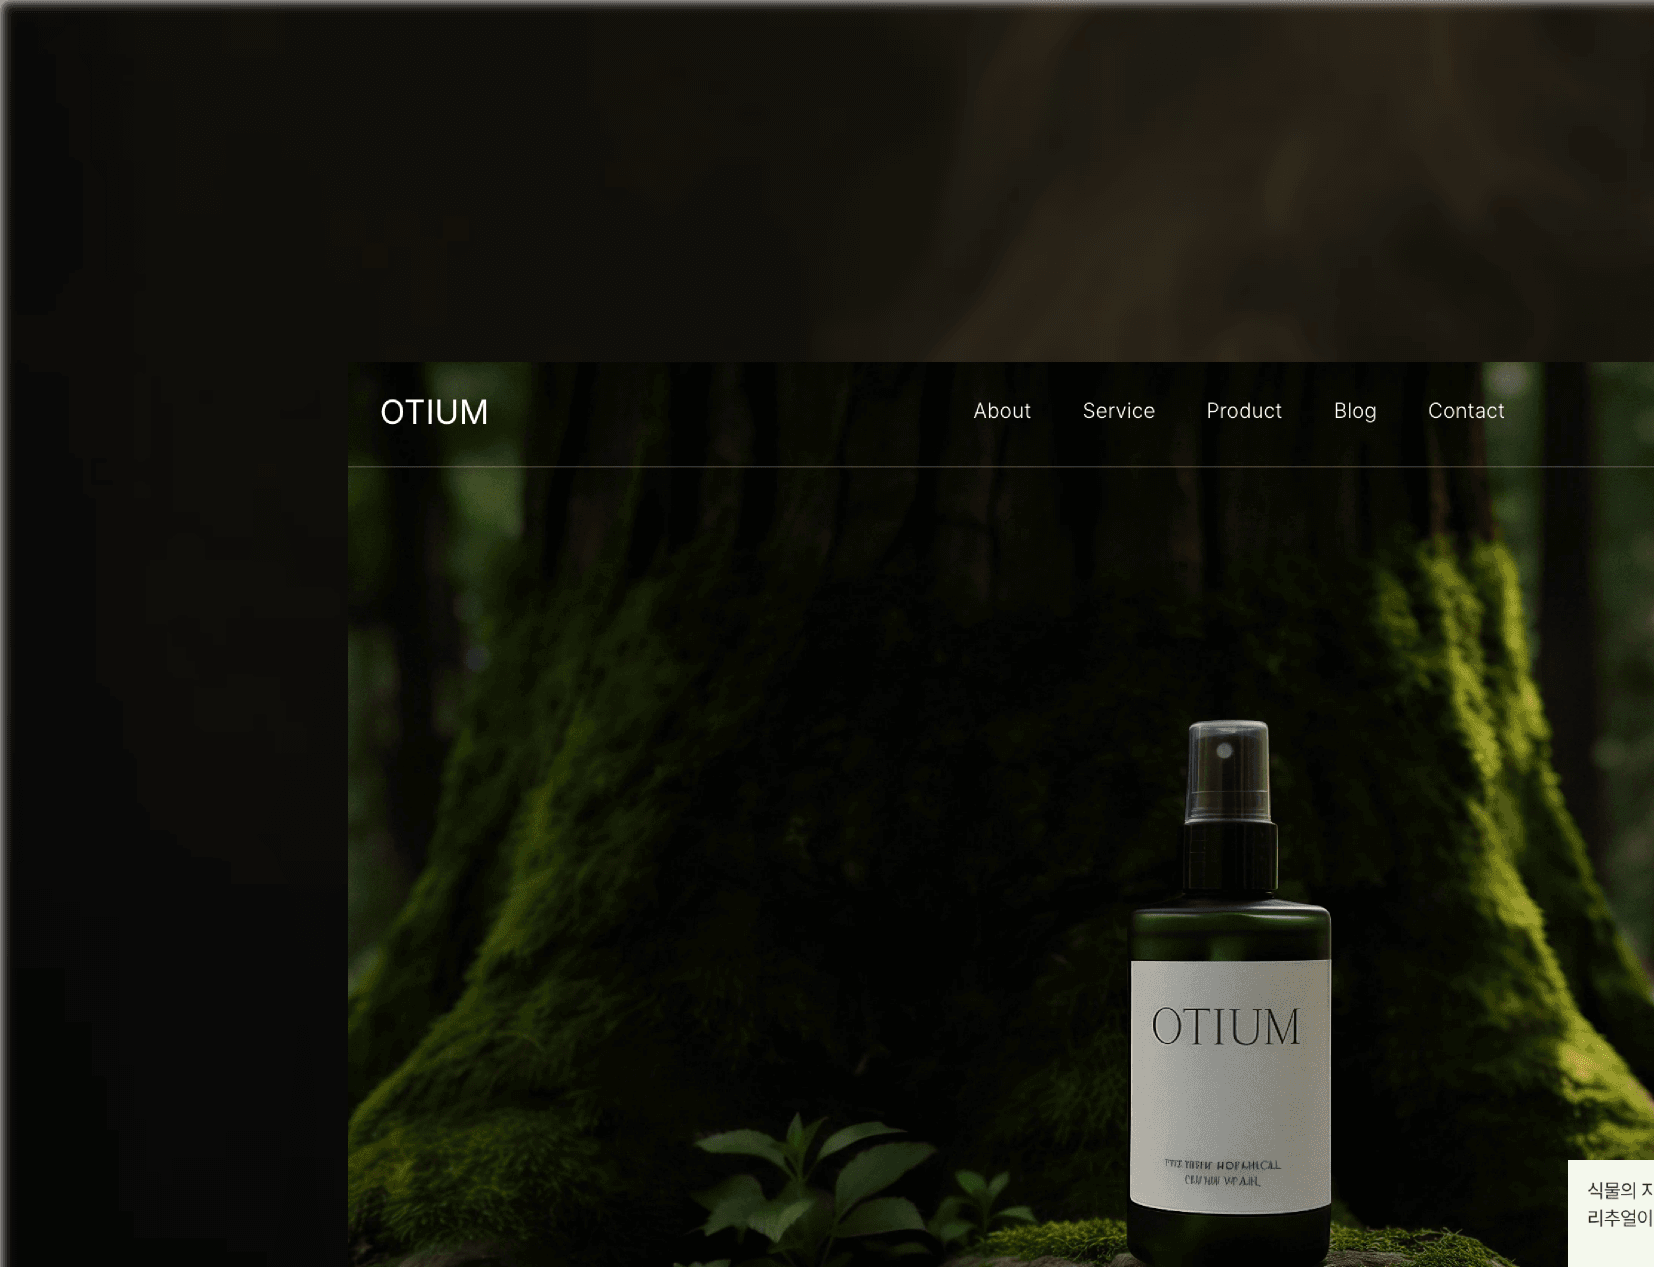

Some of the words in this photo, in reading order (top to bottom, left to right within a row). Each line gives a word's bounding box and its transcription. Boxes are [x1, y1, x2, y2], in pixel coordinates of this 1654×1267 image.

[381, 398, 487, 425] OTIUM
[973, 401, 1032, 419] About
[1083, 401, 1156, 419] Service
[1207, 401, 1283, 419] Product
[1335, 401, 1376, 424] Blog
[1428, 401, 1505, 419] Contact
[1152, 1007, 1301, 1046] OTIUM
[1587, 1181, 1636, 1200] 식물의
[1588, 1209, 1653, 1228] 리추얼이
